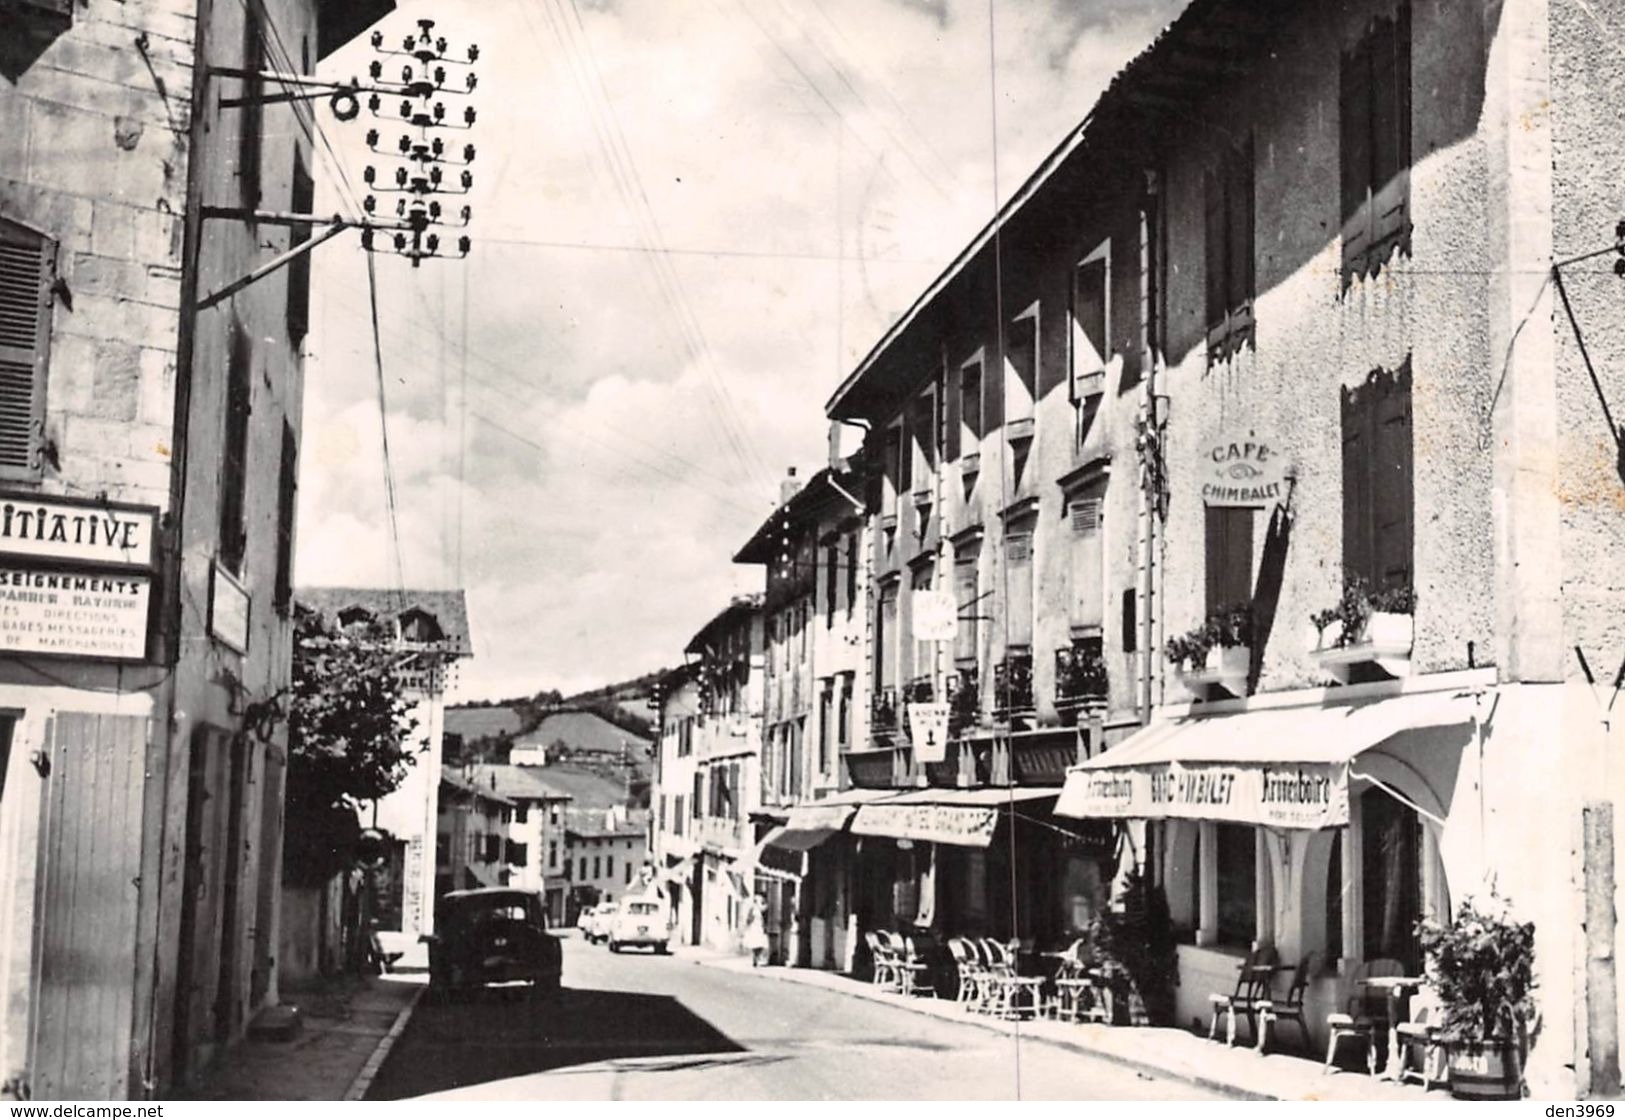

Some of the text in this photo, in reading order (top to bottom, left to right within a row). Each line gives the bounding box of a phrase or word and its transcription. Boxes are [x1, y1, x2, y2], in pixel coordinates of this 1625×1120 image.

[1202, 482, 1280, 501] CHIMBALET
[0, 605, 118, 622] ES DIRECTIONS
